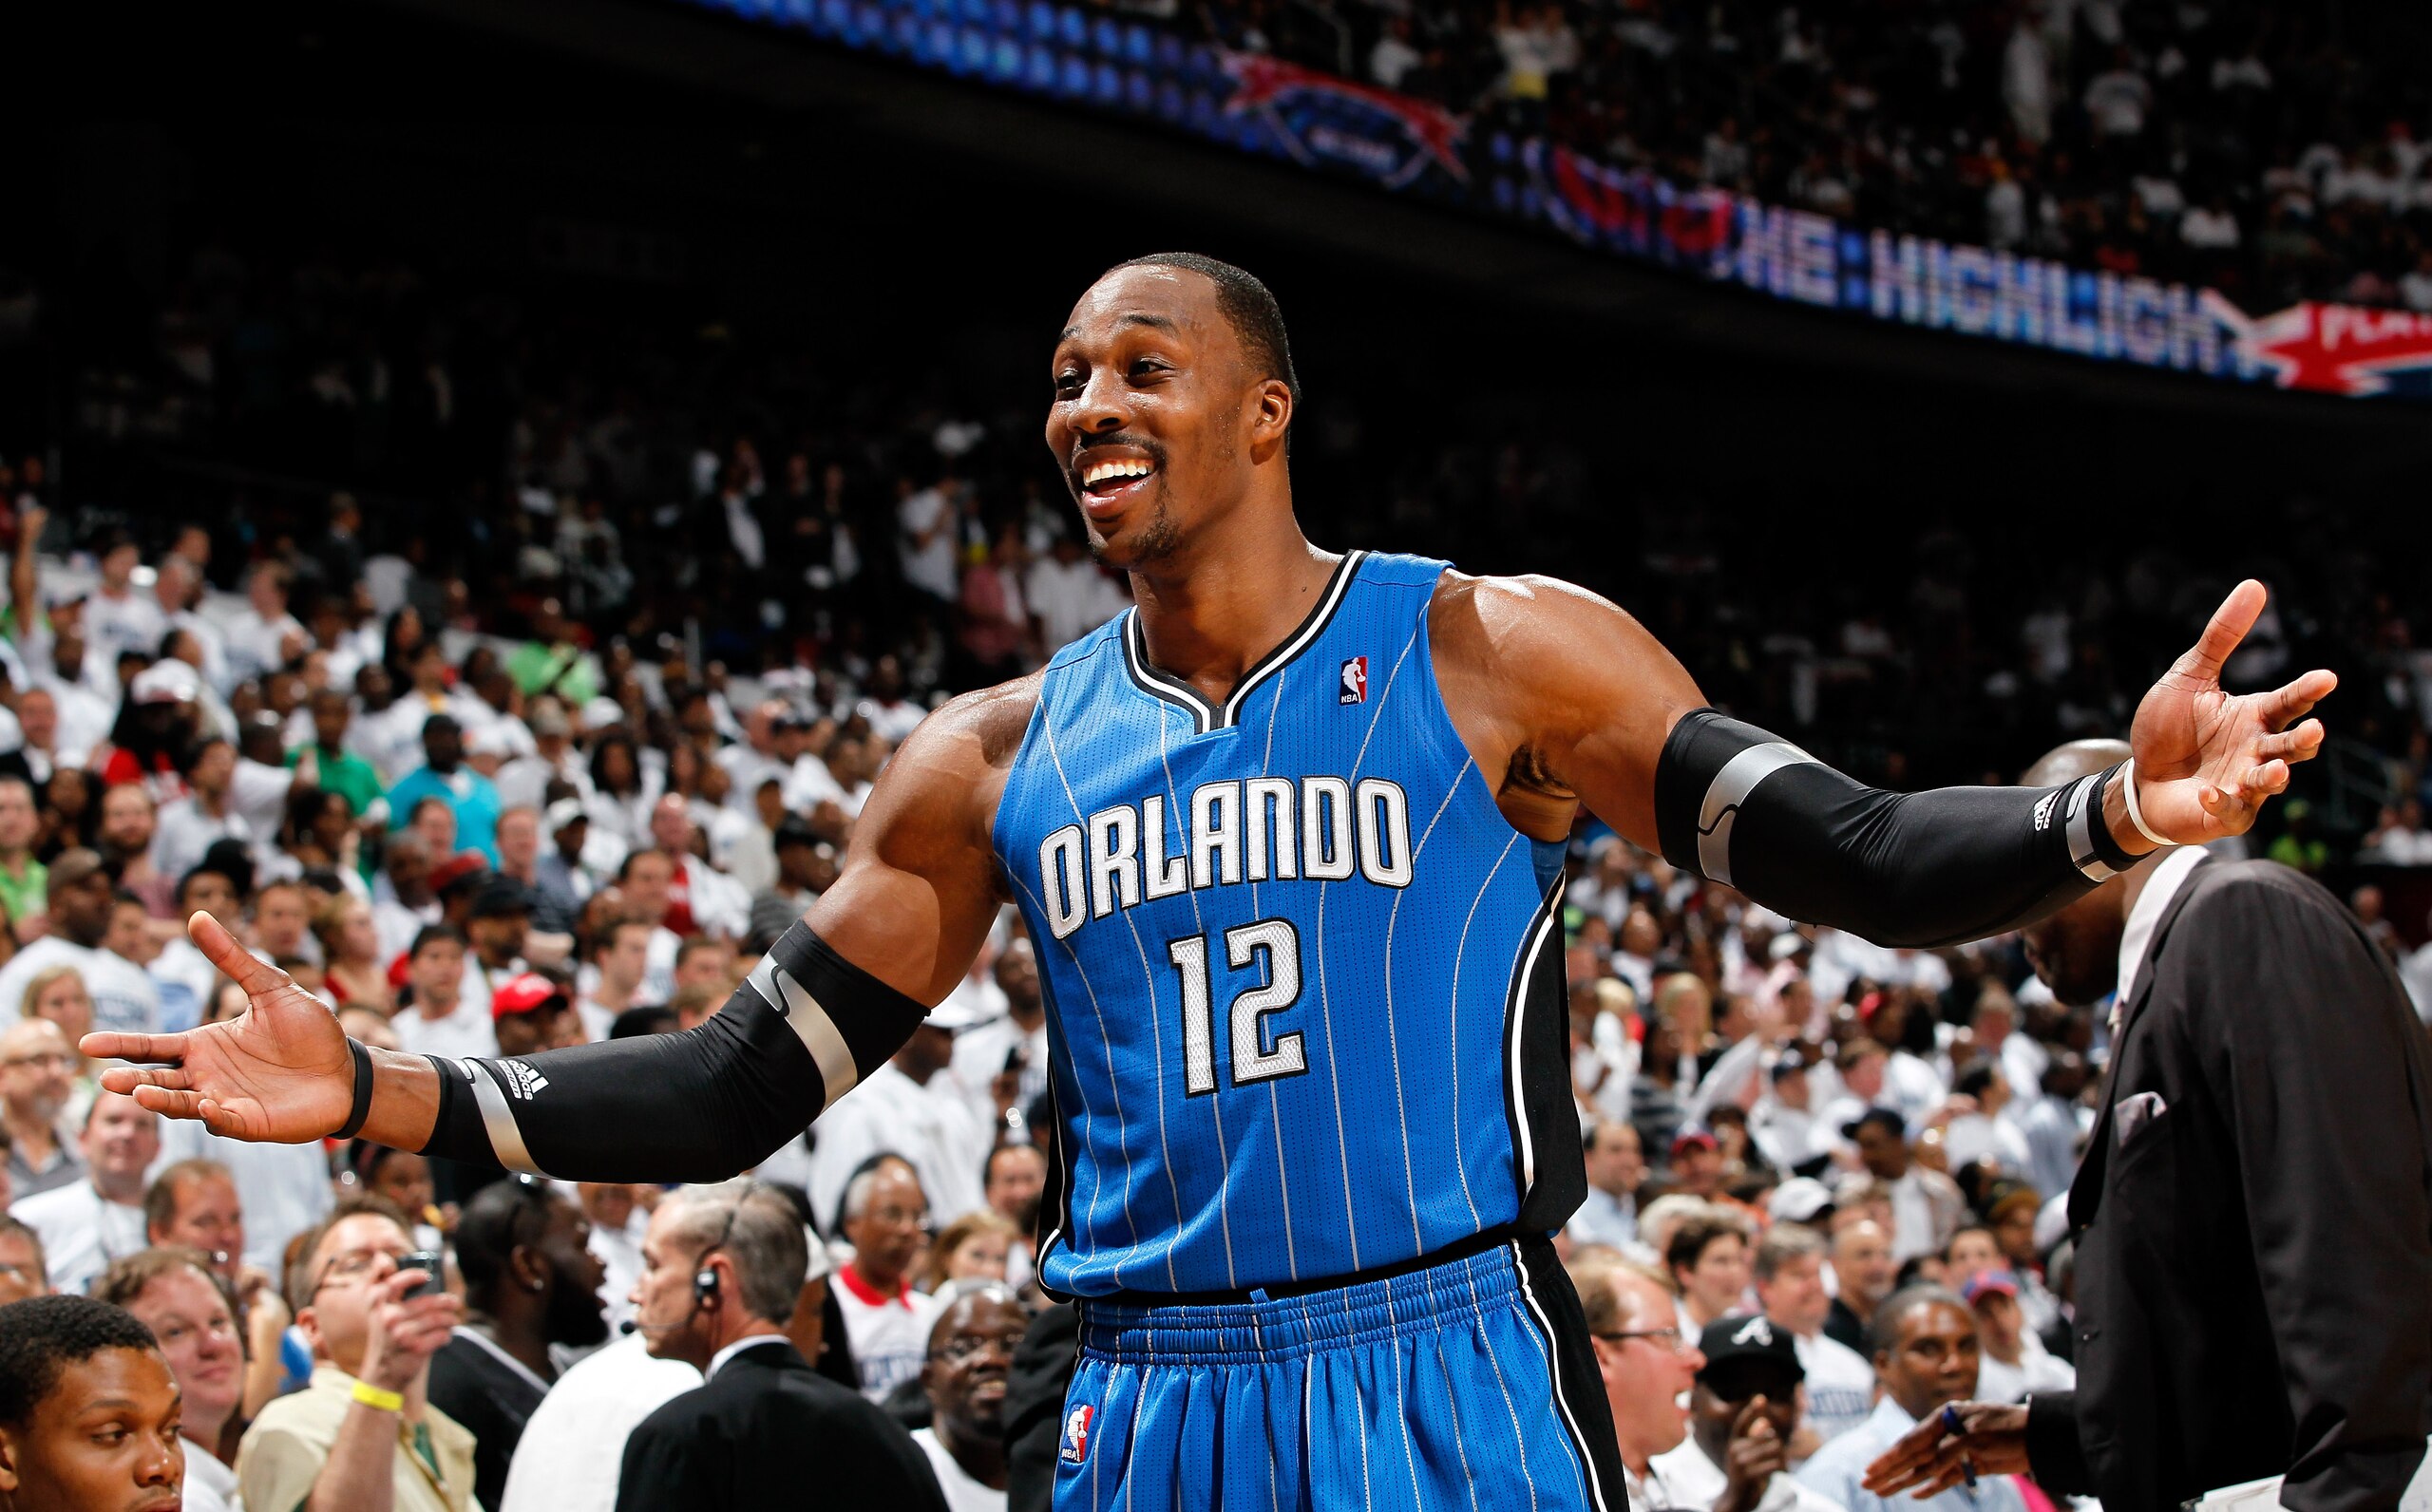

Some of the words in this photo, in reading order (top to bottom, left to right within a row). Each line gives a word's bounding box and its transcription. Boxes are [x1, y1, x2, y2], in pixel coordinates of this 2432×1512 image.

[1340, 693, 1358, 704] NBA
[1038, 774, 1415, 941] ORLANDO
[1166, 917, 1311, 1098] 12
[507, 1059, 534, 1101] adidas
[1061, 1447, 1077, 1460] NBA
